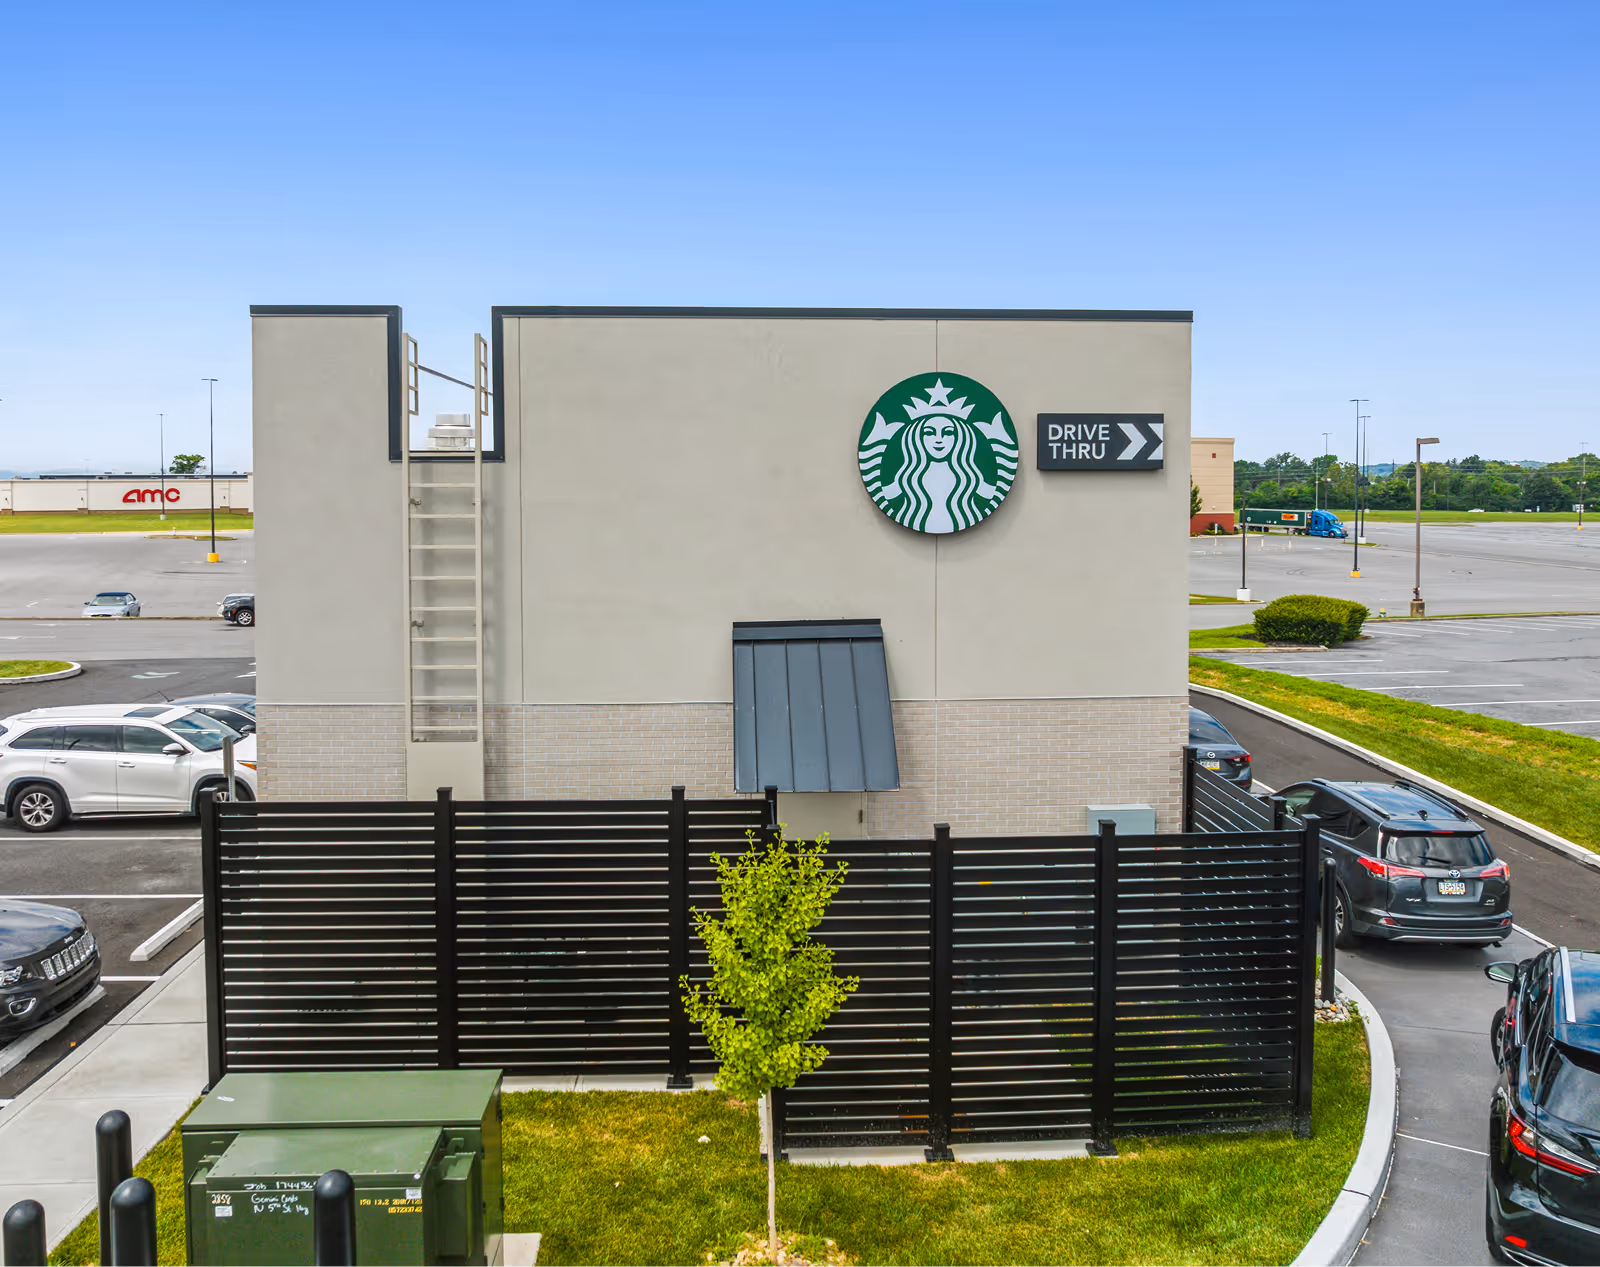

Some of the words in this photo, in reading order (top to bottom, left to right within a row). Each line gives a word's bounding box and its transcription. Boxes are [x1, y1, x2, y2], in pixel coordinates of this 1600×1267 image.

[1048, 424, 1110, 441] DRIVE
[1048, 443, 1106, 459] THRU
[254, 1205, 264, 1214] N
